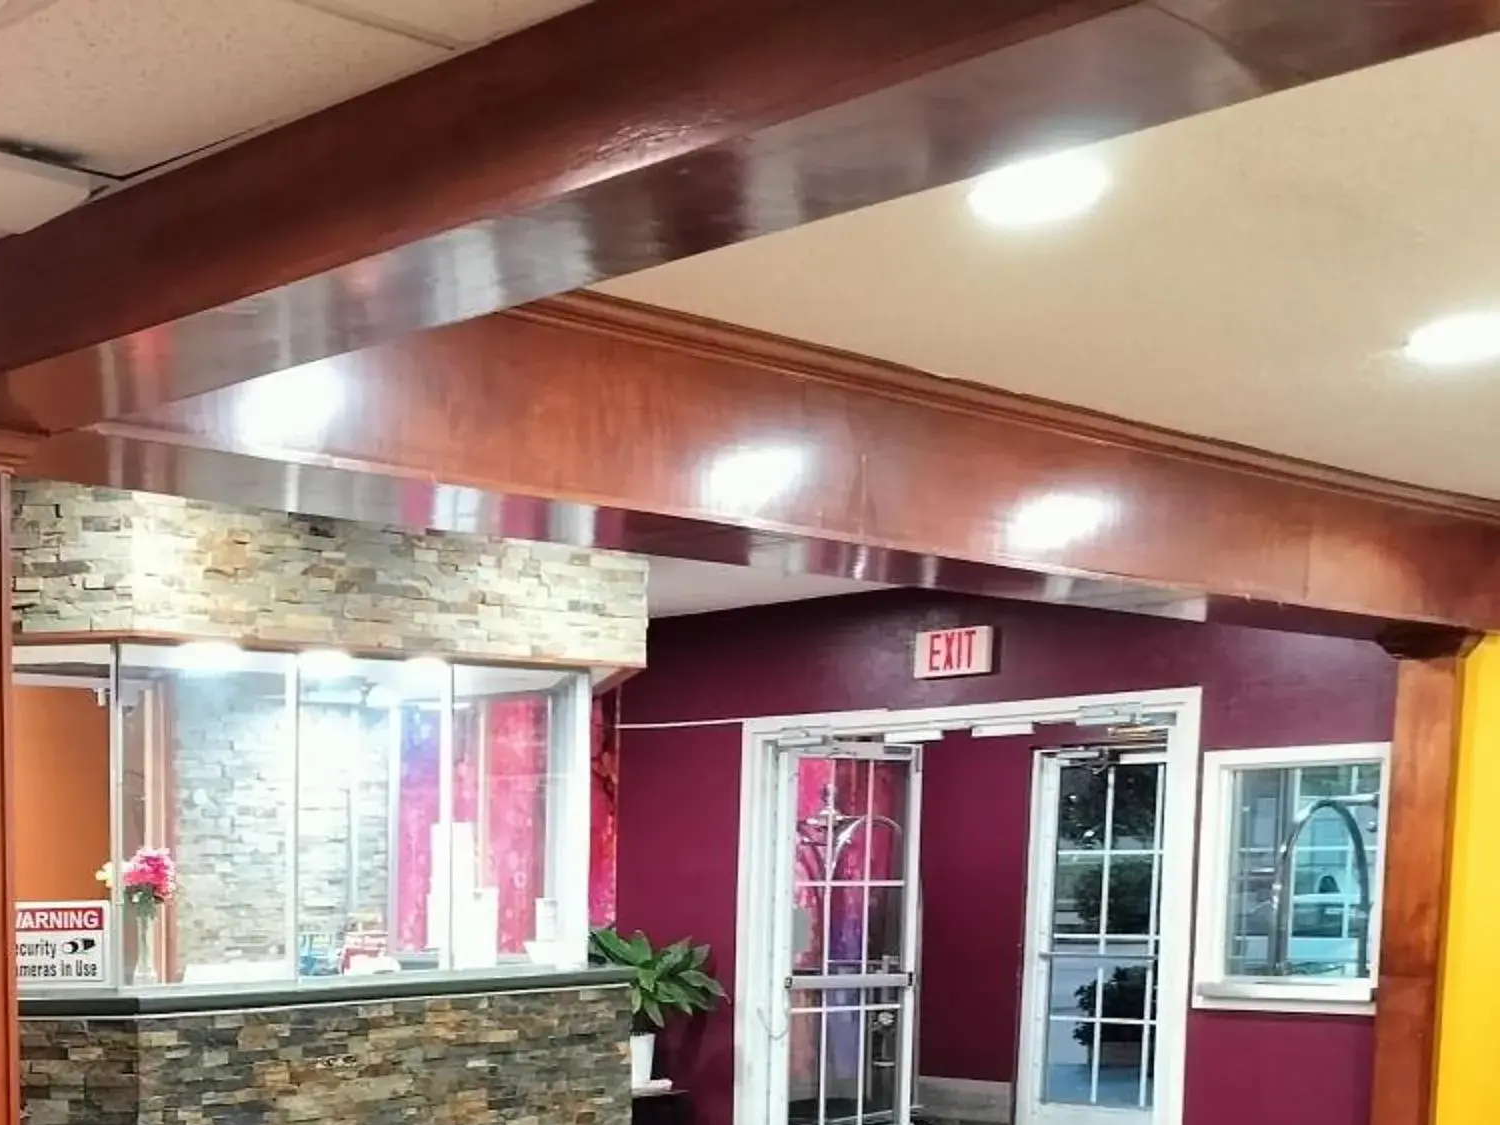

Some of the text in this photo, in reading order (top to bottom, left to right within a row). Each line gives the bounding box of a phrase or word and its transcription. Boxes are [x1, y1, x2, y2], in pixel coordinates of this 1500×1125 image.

[929, 630, 976, 672] EXIT
[15, 939, 57, 958] curity
[15, 962, 57, 977] meras
[75, 959, 97, 977] Use
